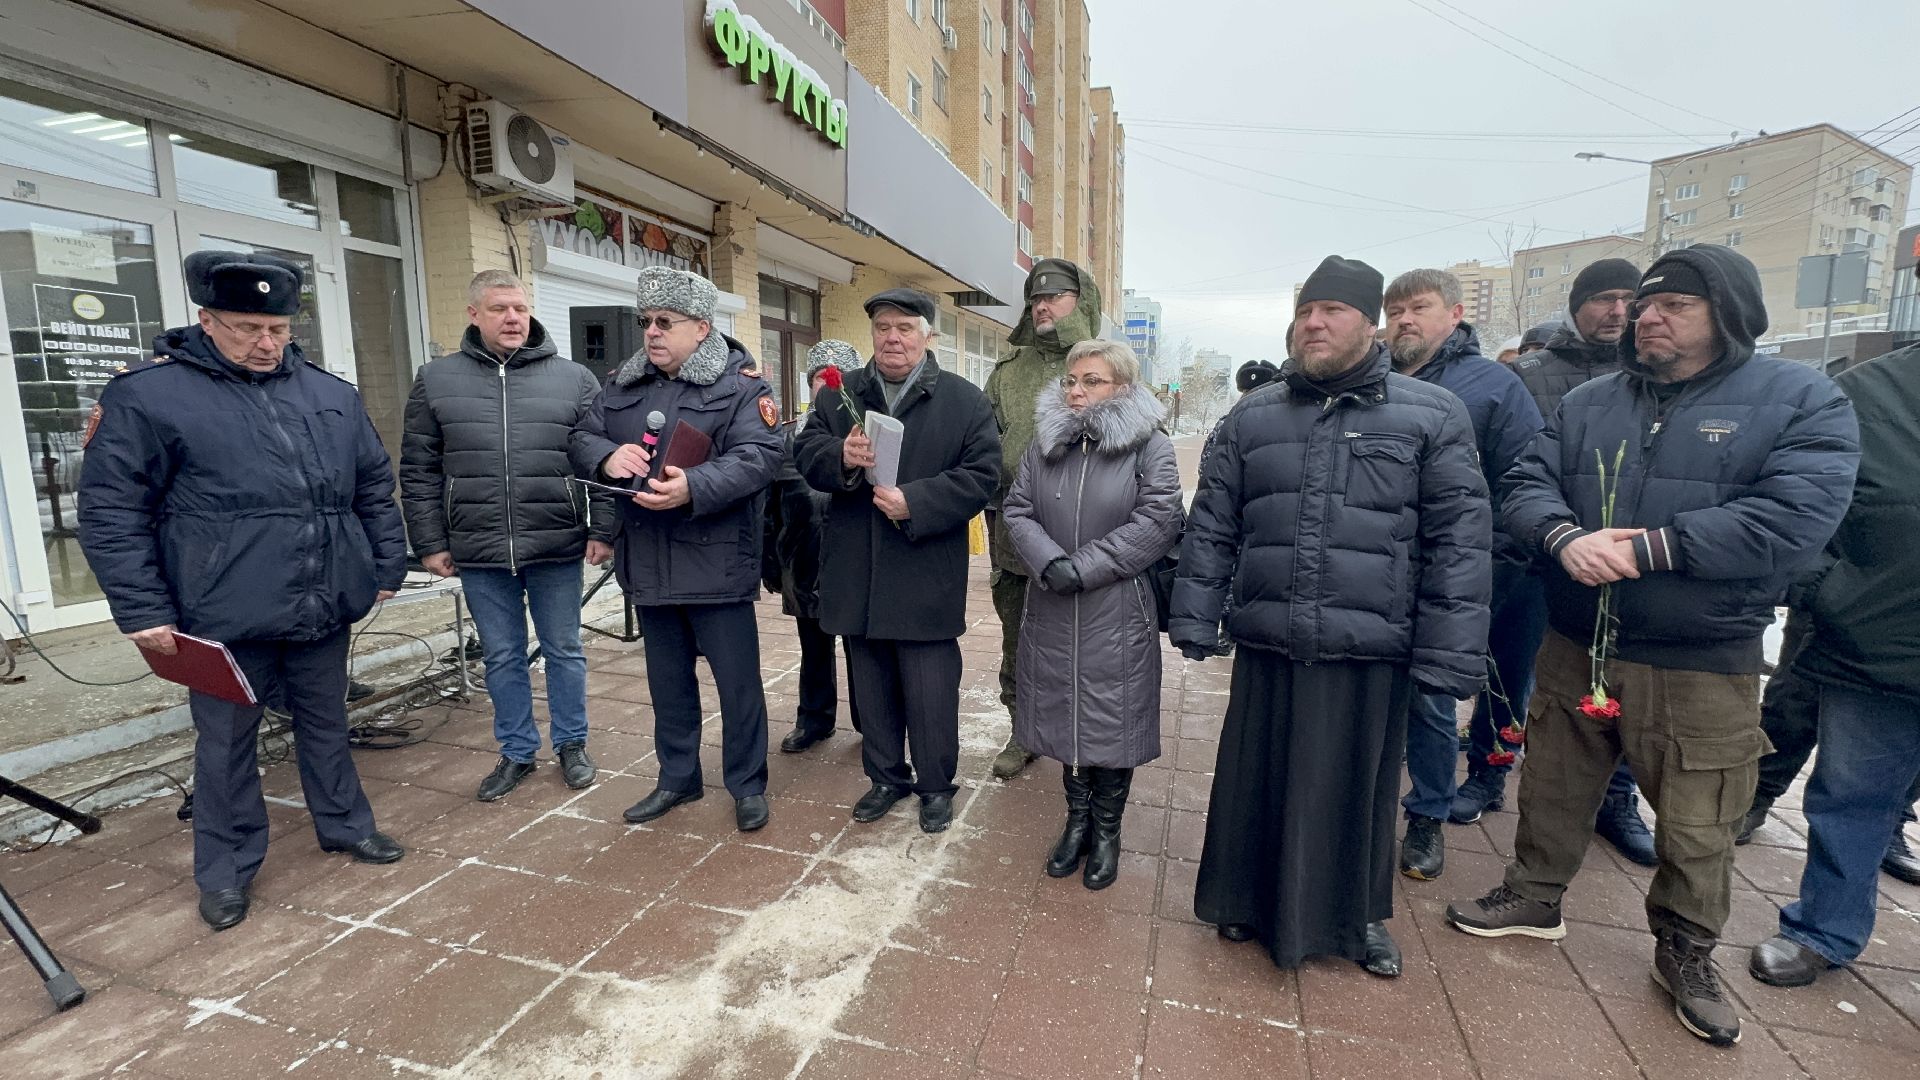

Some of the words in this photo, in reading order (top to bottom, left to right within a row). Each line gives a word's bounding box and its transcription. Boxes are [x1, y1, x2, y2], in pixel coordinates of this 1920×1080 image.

[714, 8, 847, 150] ФРУКТЫ
[50, 320, 87, 336] ВЕЙП
[87, 324, 131, 339] ТАБАК
[64, 357, 93, 366] 10:00
